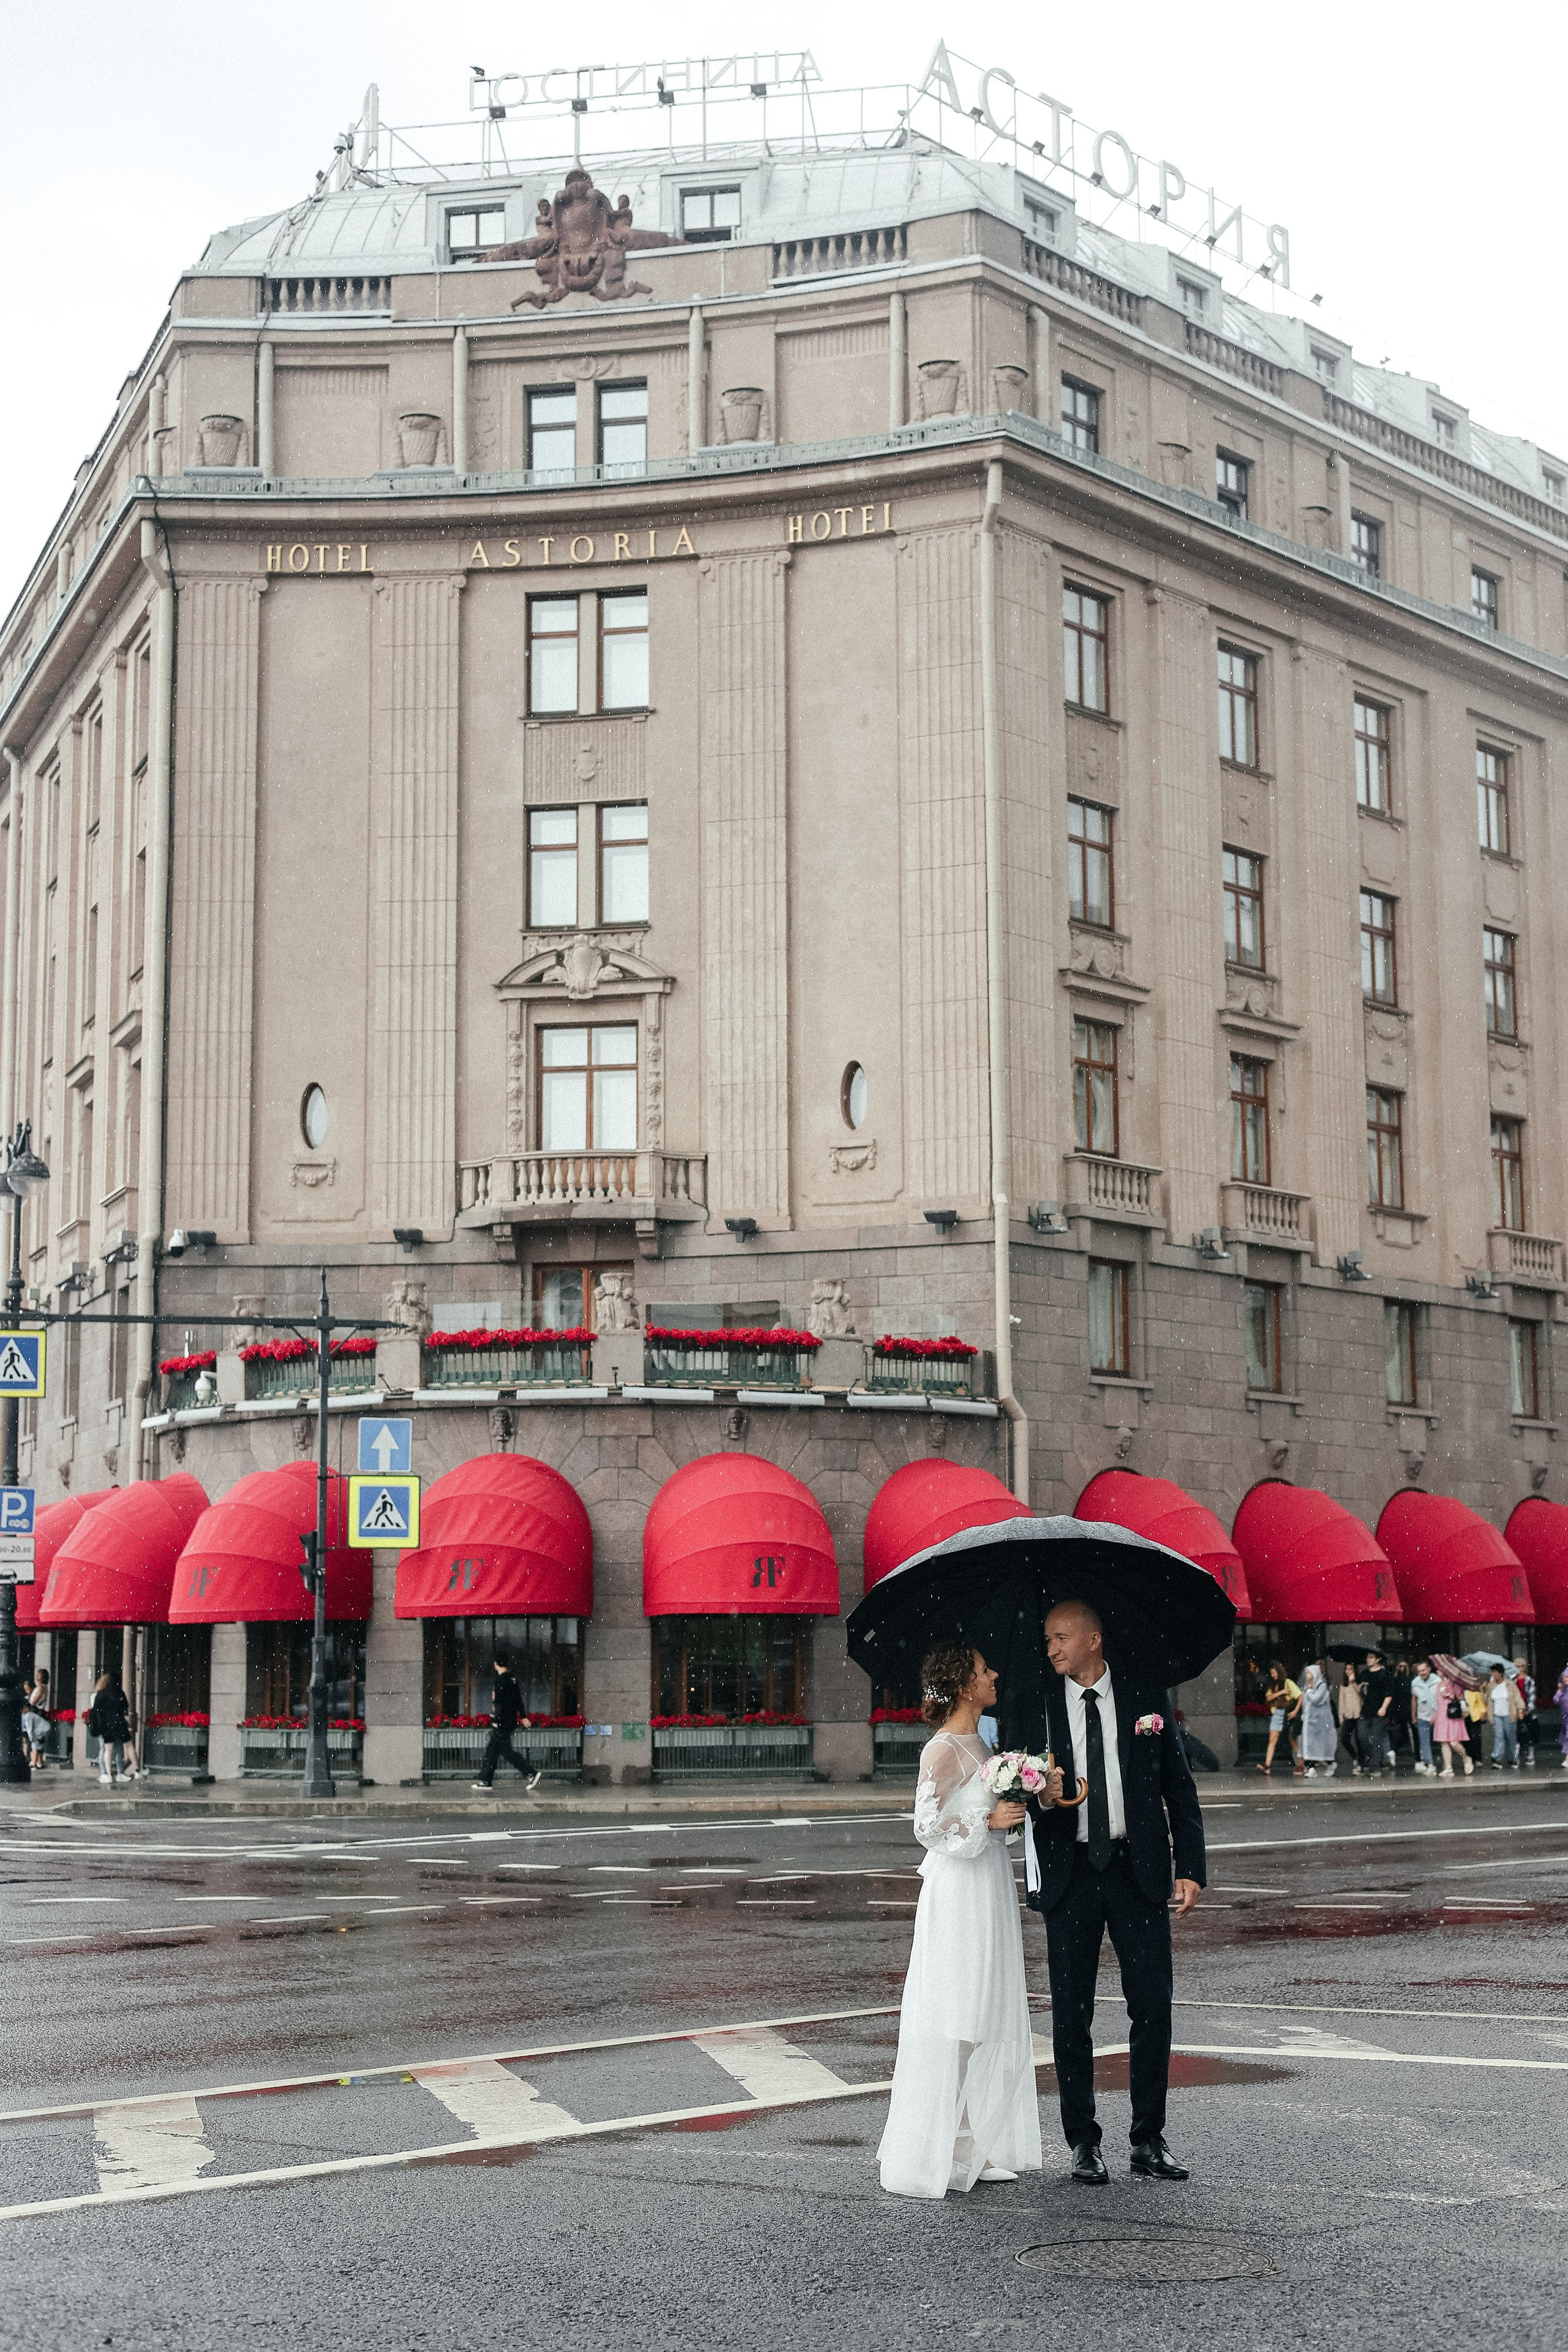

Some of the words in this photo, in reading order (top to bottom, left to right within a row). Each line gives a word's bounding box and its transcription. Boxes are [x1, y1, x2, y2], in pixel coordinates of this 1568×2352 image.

[469, 48, 823, 111] ГОСТИНИЦА
[918, 37, 1290, 288] АСТОРИЯ
[266, 543, 374, 572] HOTEL
[470, 524, 696, 568] ASTORIA
[788, 502, 897, 543] HOTEL
[1, 1491, 28, 1529] P
